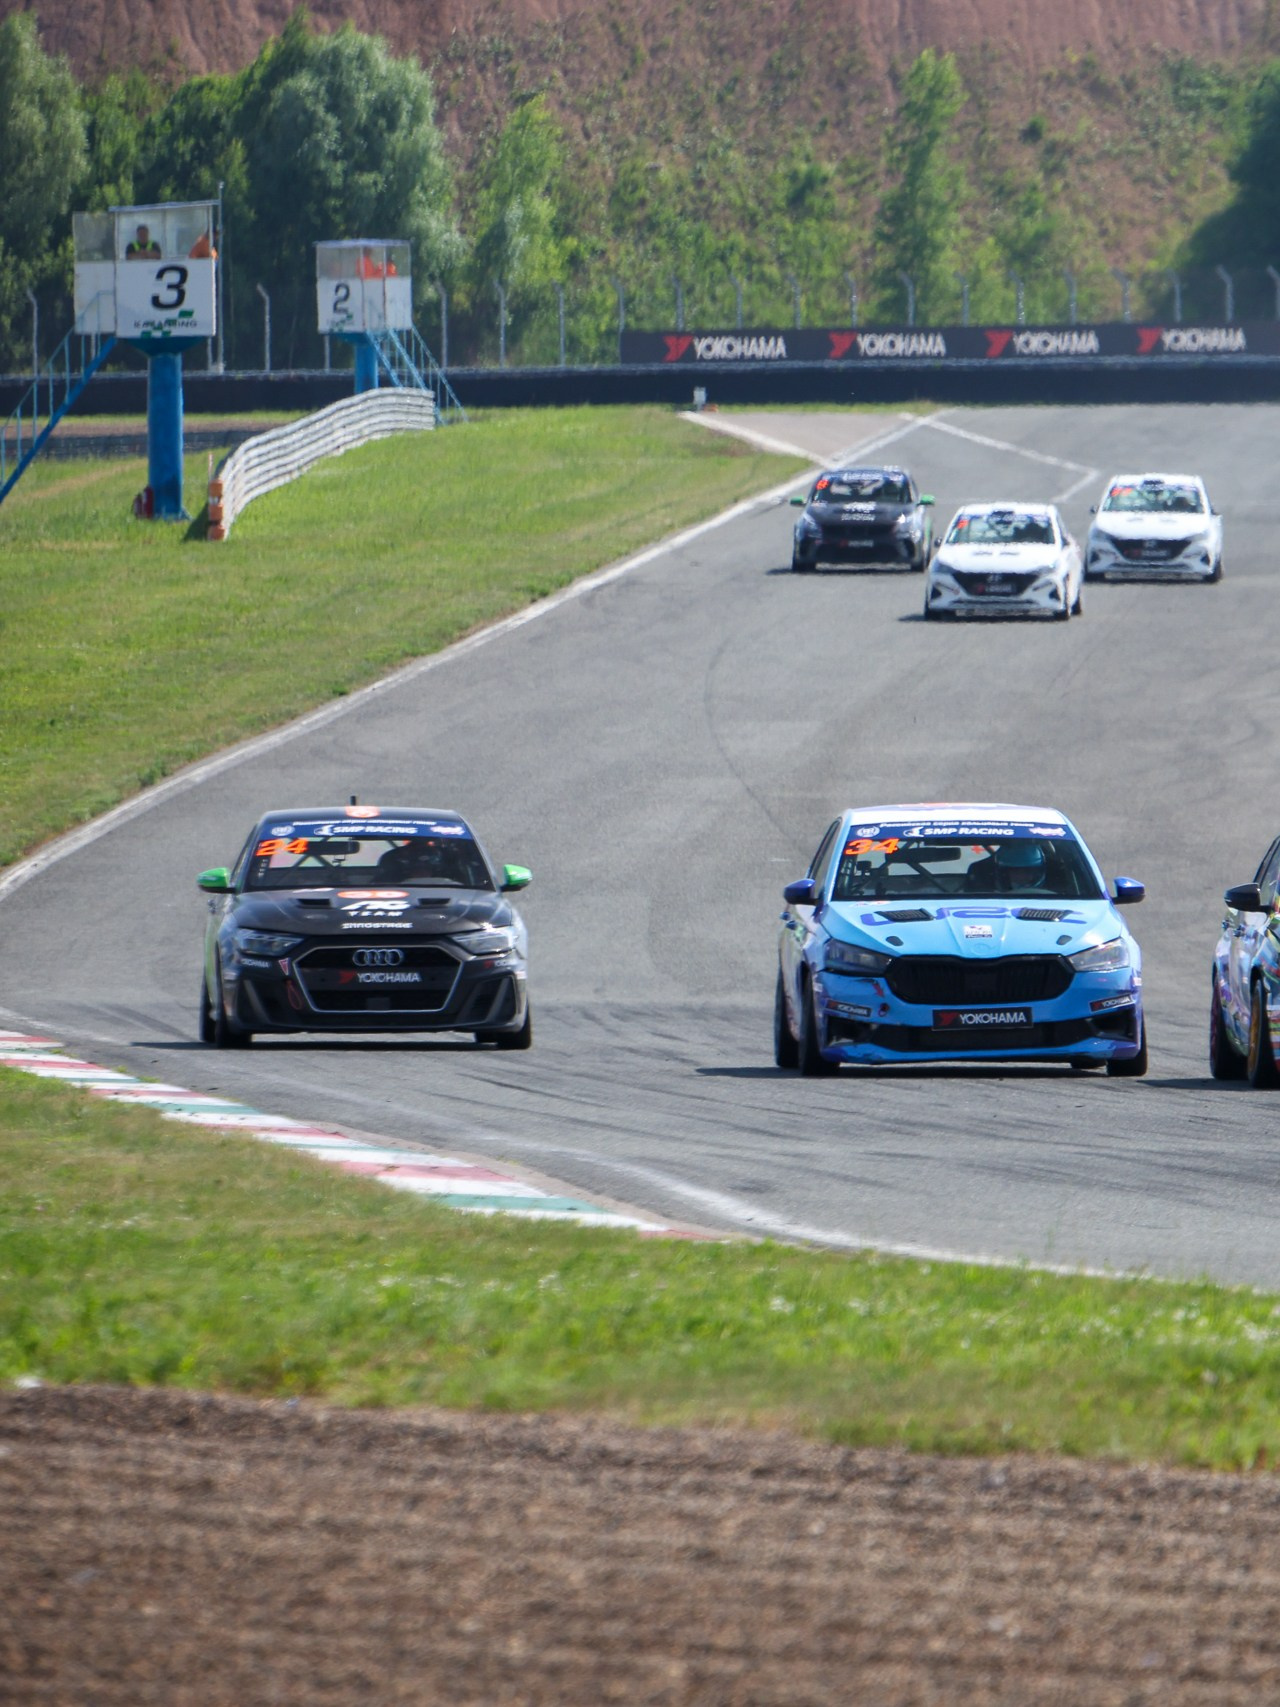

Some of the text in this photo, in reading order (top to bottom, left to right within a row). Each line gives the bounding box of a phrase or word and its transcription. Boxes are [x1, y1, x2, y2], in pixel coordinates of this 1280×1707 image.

[151, 265, 188, 309] 3
[333, 283, 350, 313] 2
[693, 336, 787, 360] YOKOHAMA
[856, 333, 946, 357] YOKOHAMA
[1013, 330, 1100, 354] YOKOHAMA
[366, 826, 418, 834] RACING
[924, 827, 1014, 835] SMP RACING
[256, 838, 310, 857] 24
[844, 838, 900, 855] 34
[357, 972, 420, 983] YOKOHAMA
[959, 1011, 1027, 1025] YOKOHAMA
